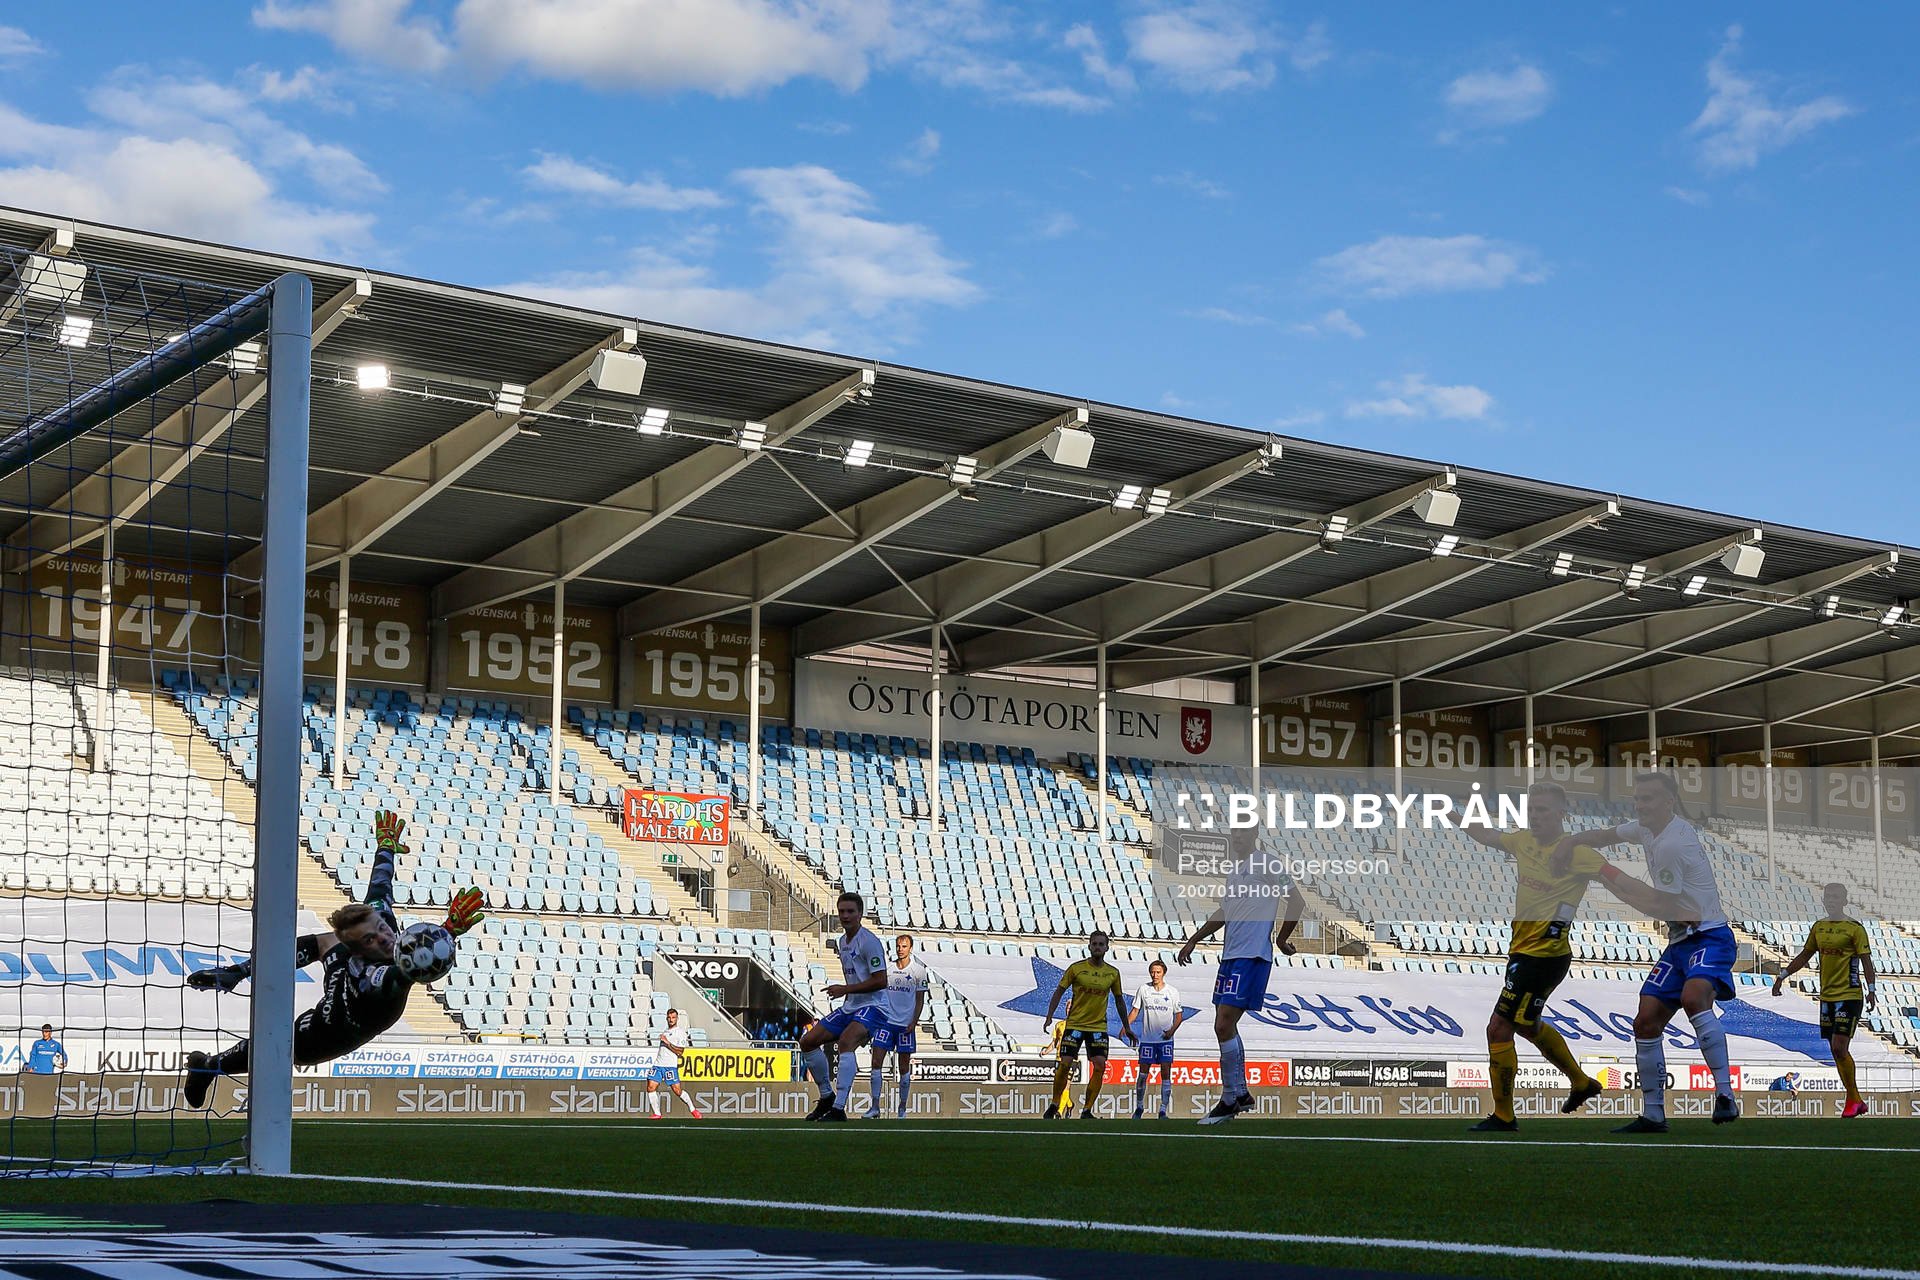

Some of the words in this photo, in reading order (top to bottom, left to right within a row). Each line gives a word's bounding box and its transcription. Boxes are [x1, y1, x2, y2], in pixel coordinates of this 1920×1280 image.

[47, 559, 104, 578] SVENSKA
[135, 570, 192, 585] MÄSTARE
[349, 592, 401, 608] MÄSTARE
[40, 585, 200, 648] 1947
[468, 607, 518, 620] SVENSKA
[304, 613, 410, 669] 948
[652, 630, 698, 640] SVENSKA
[721, 634, 767, 647] MÄSTAE
[461, 630, 601, 689] 1952
[645, 649, 775, 705] 1956
[1314, 701, 1350, 711] MÄSTARE
[1262, 714, 1356, 760] 1957
[1508, 740, 1595, 784] 1962
[1828, 772, 1906, 813] 205
[630, 794, 724, 823] HÅRDHS
[630, 819, 695, 841] MÅLERI
[700, 827, 724, 842] AB
[672, 959, 740, 980] exeo
[888, 985, 911, 993] OLMEN
[338, 1065, 393, 1076] VERKSTAD
[396, 1066, 410, 1077] AB
[424, 1066, 476, 1077] VERKSTAD
[478, 1067, 492, 1077] AB
[505, 1067, 558, 1078] VERKSTAD
[560, 1069, 574, 1078] AB
[587, 1068, 637, 1079] VERKSTAD
[678, 1055, 775, 1078] PACKOPLOCK
[912, 1064, 990, 1075] HYDROSCAND
[1120, 1060, 1160, 1084] ÅY
[1170, 1067, 1223, 1086] FASA
[1294, 1065, 1331, 1081] KSAB
[1374, 1066, 1410, 1082] KSAB
[1457, 1069, 1482, 1079] MBA
[232, 1083, 370, 1112] sdium
[397, 1084, 526, 1112] stadium
[695, 1087, 809, 1113] stadium
[848, 1087, 940, 1113] tadium
[1191, 1090, 1280, 1114] stum
[1297, 1091, 1382, 1115] stadium
[1398, 1092, 1480, 1115] stadium
[1585, 1093, 1645, 1115] stadiu
[1756, 1095, 1823, 1116] stadium
[1834, 1096, 1899, 1116] sdium
